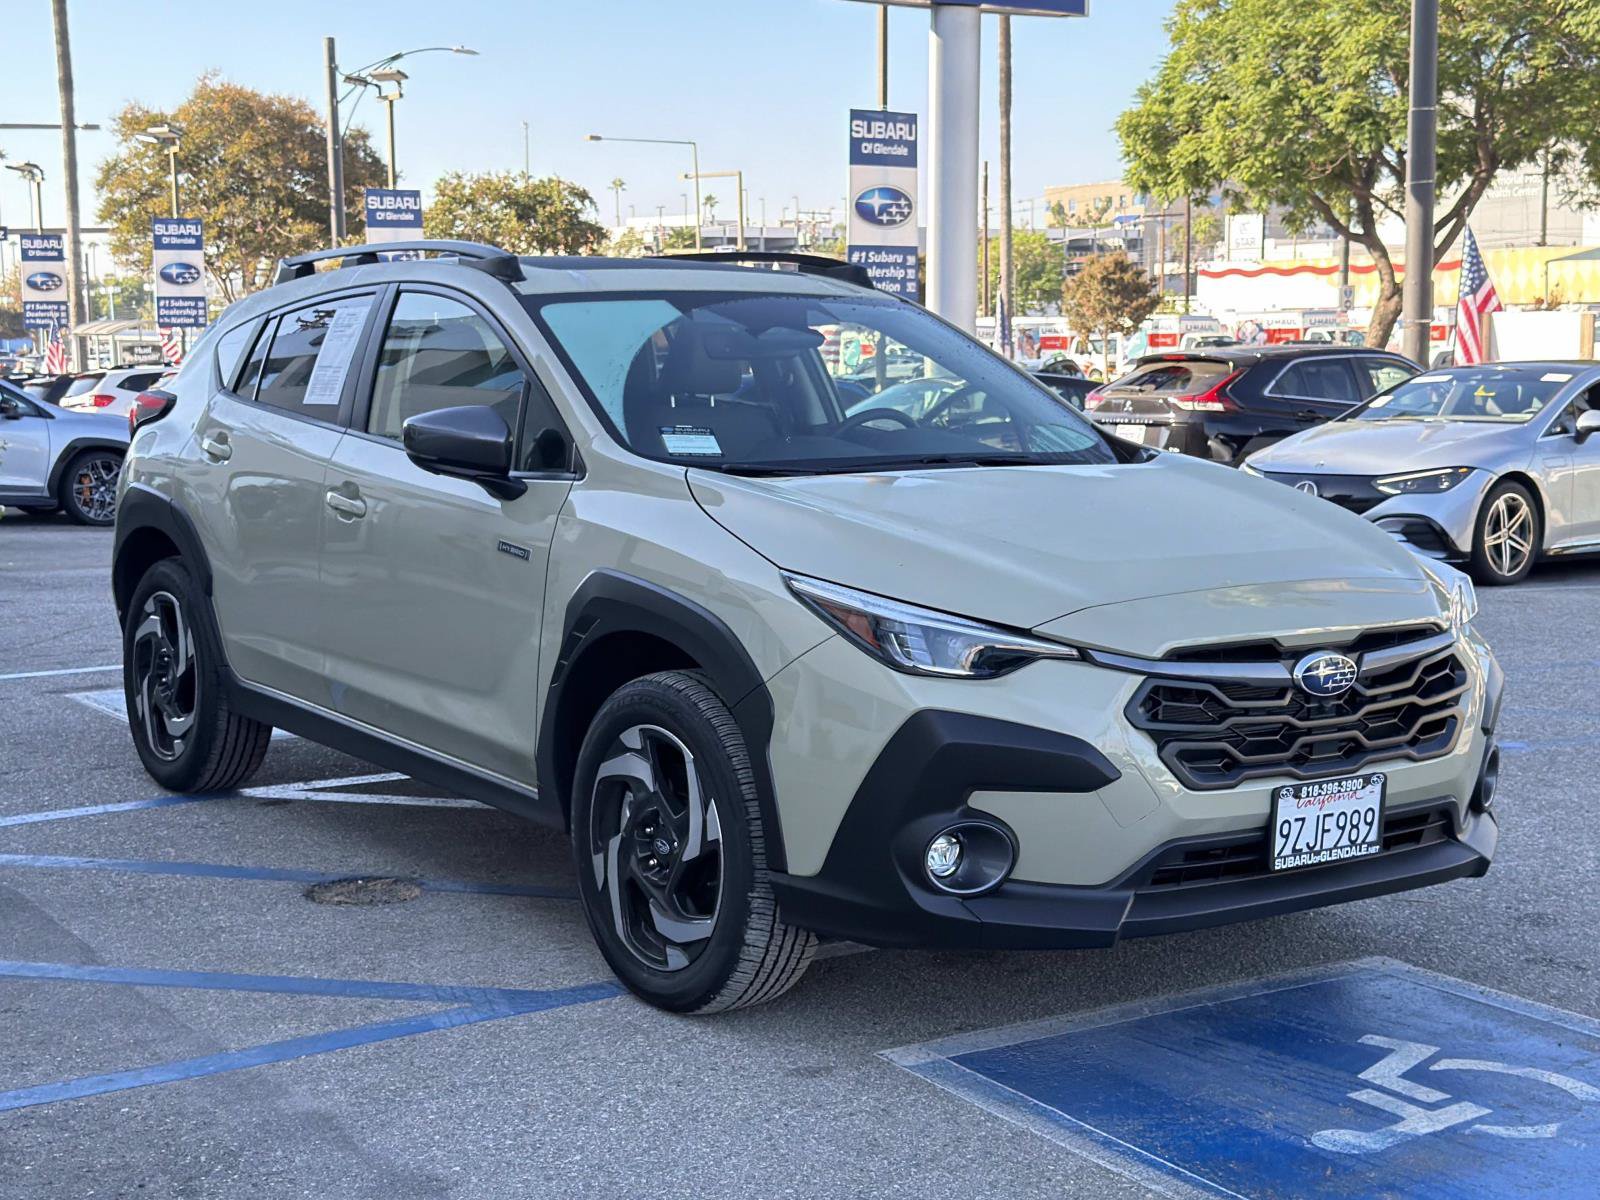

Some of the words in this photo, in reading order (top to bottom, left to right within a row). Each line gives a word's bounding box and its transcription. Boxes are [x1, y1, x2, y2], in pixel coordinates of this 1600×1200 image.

[851, 120, 916, 141] SUBARU
[861, 143, 873, 154] Of
[873, 143, 909, 156] Glendale
[367, 195, 420, 210] SUBARU
[376, 211, 385, 220] Of
[154, 224, 201, 236] SUBARU
[21, 239, 63, 249] SUBARU
[851, 251, 866, 263] #1
[867, 251, 904, 263] Subaru
[866, 265, 906, 280] alership
[170, 299, 195, 307] Subaru
[159, 308, 197, 316] Dealership
[1301, 778, 1364, 798] 818-396-3900
[1277, 807, 1376, 858] 9ZJF989
